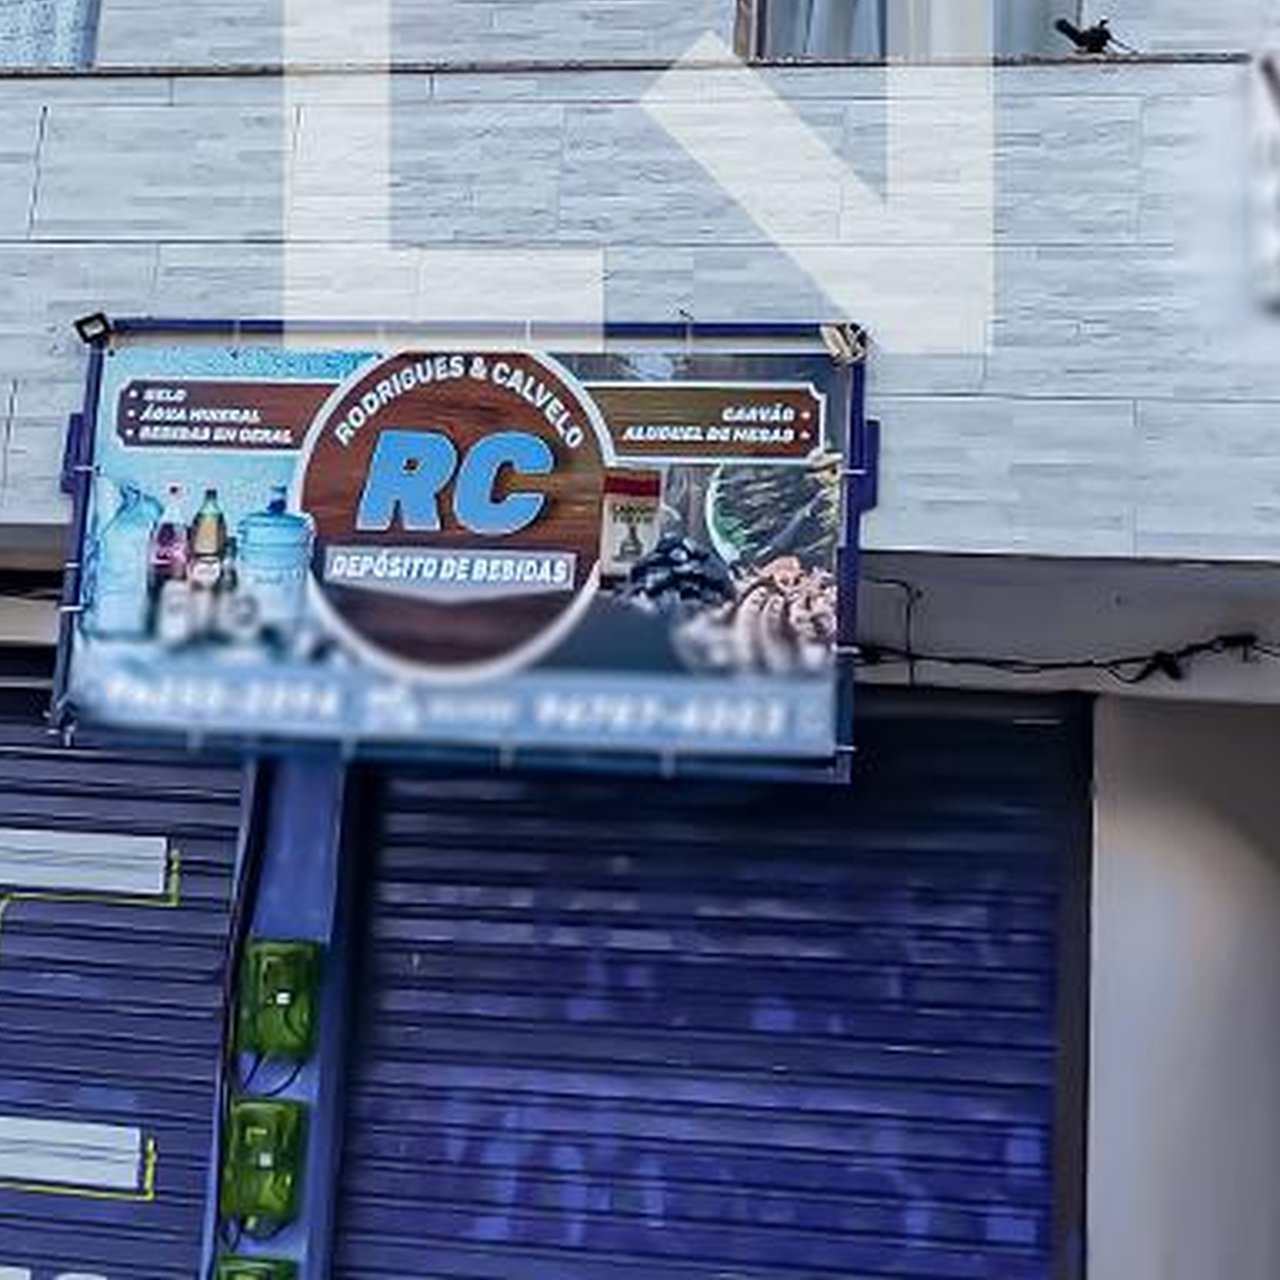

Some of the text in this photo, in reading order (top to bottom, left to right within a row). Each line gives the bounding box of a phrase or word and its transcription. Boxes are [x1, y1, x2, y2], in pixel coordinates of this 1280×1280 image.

[335, 356, 584, 448] RODRIGUES & CALVELO
[354, 427, 558, 536] RC
[333, 550, 568, 584] DEPÓSITO DE BEBIDAS
